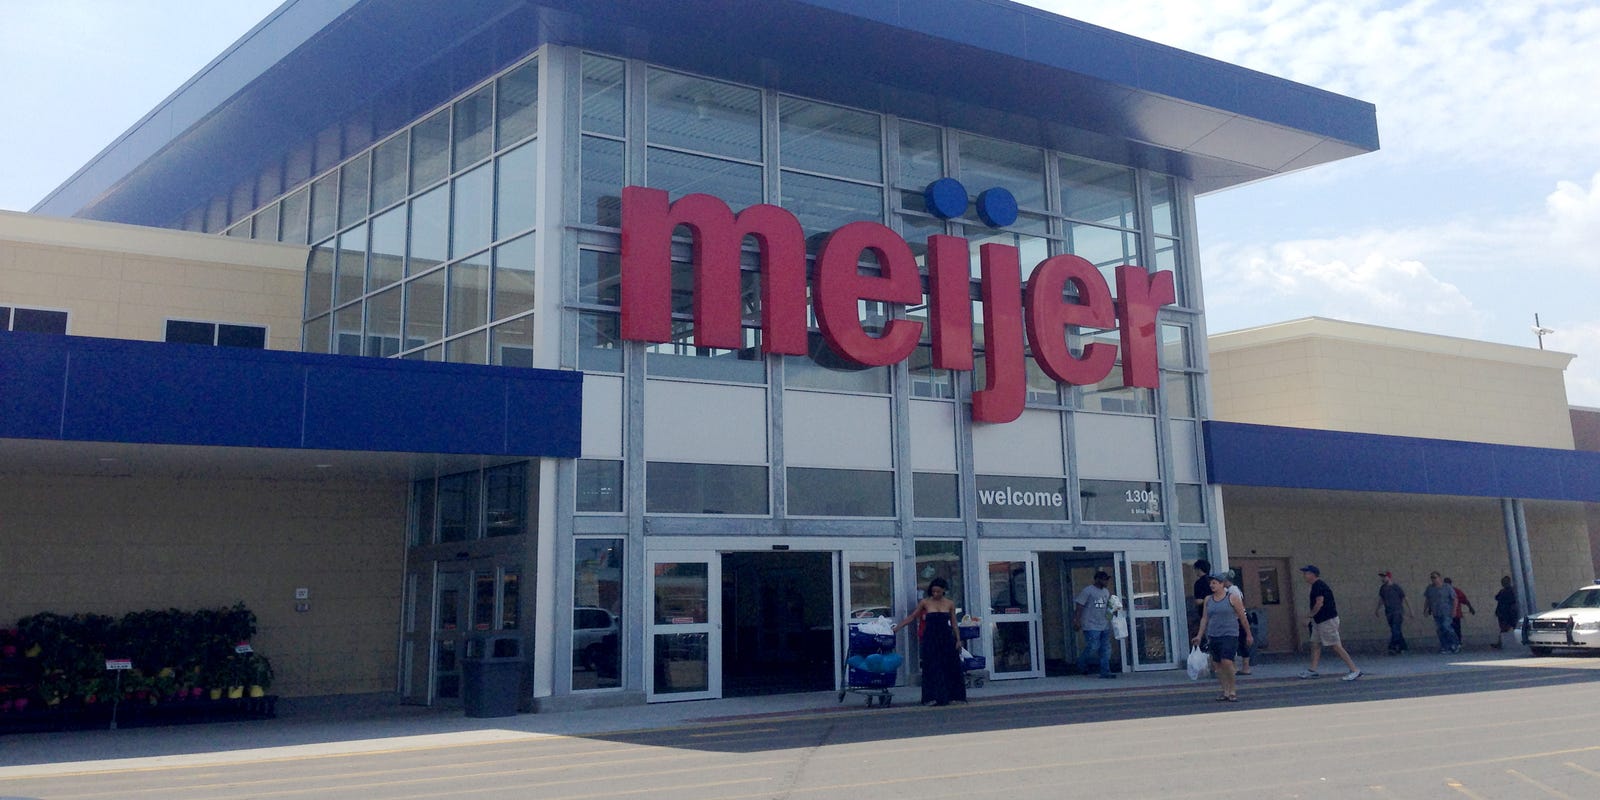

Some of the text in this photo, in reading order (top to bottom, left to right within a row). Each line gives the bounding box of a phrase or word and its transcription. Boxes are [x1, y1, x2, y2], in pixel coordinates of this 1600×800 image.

[621, 177, 1175, 424] meijer
[979, 486, 1062, 507] welcome
[1125, 489, 1156, 502] 1301
